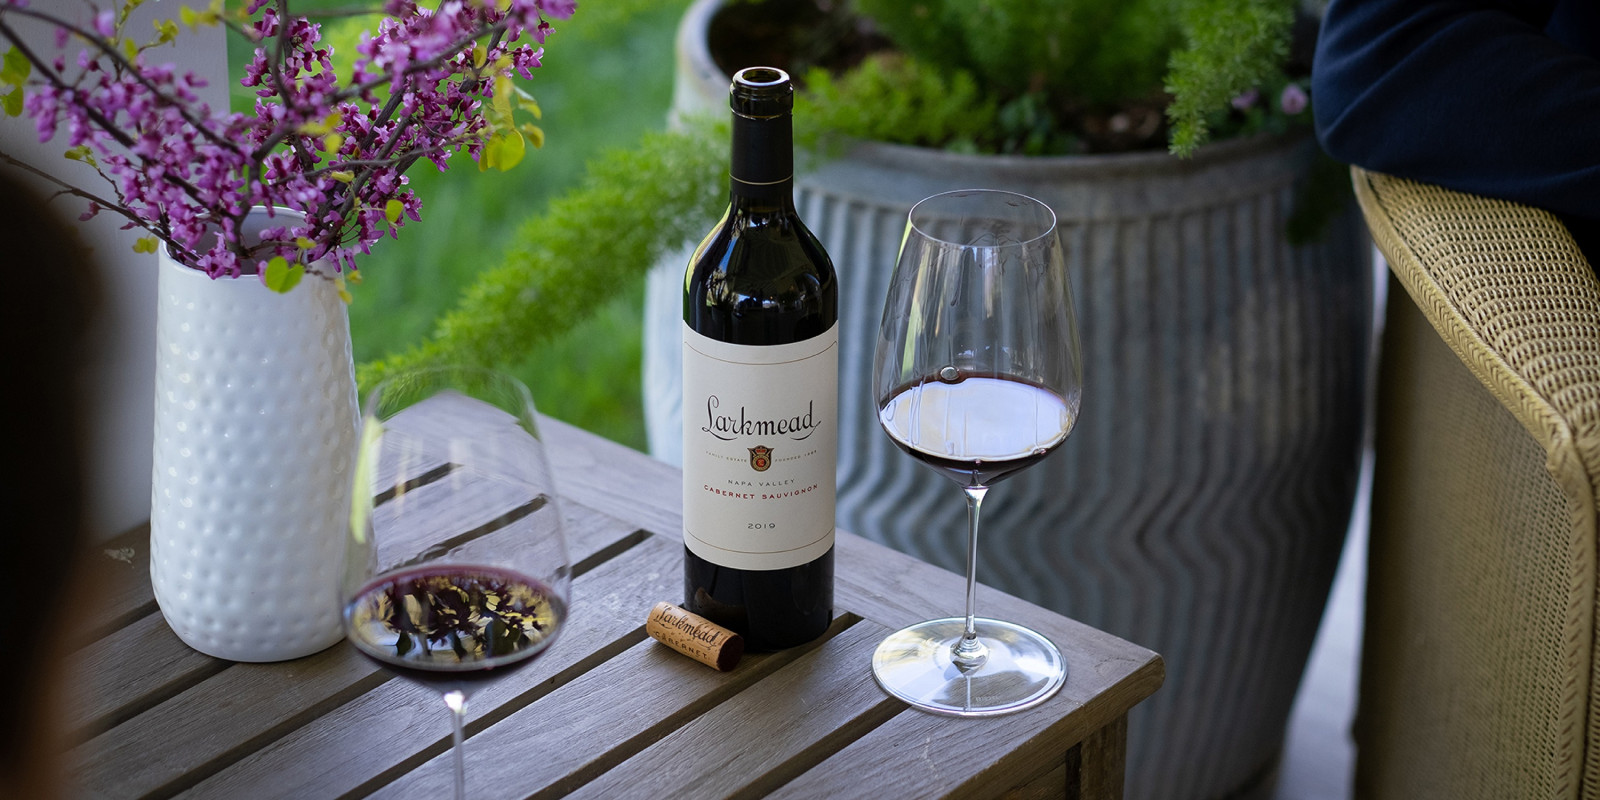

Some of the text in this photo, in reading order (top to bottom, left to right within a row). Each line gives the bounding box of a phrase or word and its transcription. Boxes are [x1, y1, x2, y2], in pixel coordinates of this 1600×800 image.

[701, 394, 821, 441] Larkmead
[703, 483, 818, 500] CABERNET SAUVIGNON
[727, 478, 795, 487] NAPA VALLEY
[747, 522, 776, 530] 2019
[653, 605, 719, 650] Larkmead
[654, 630, 708, 660] CABERNET
